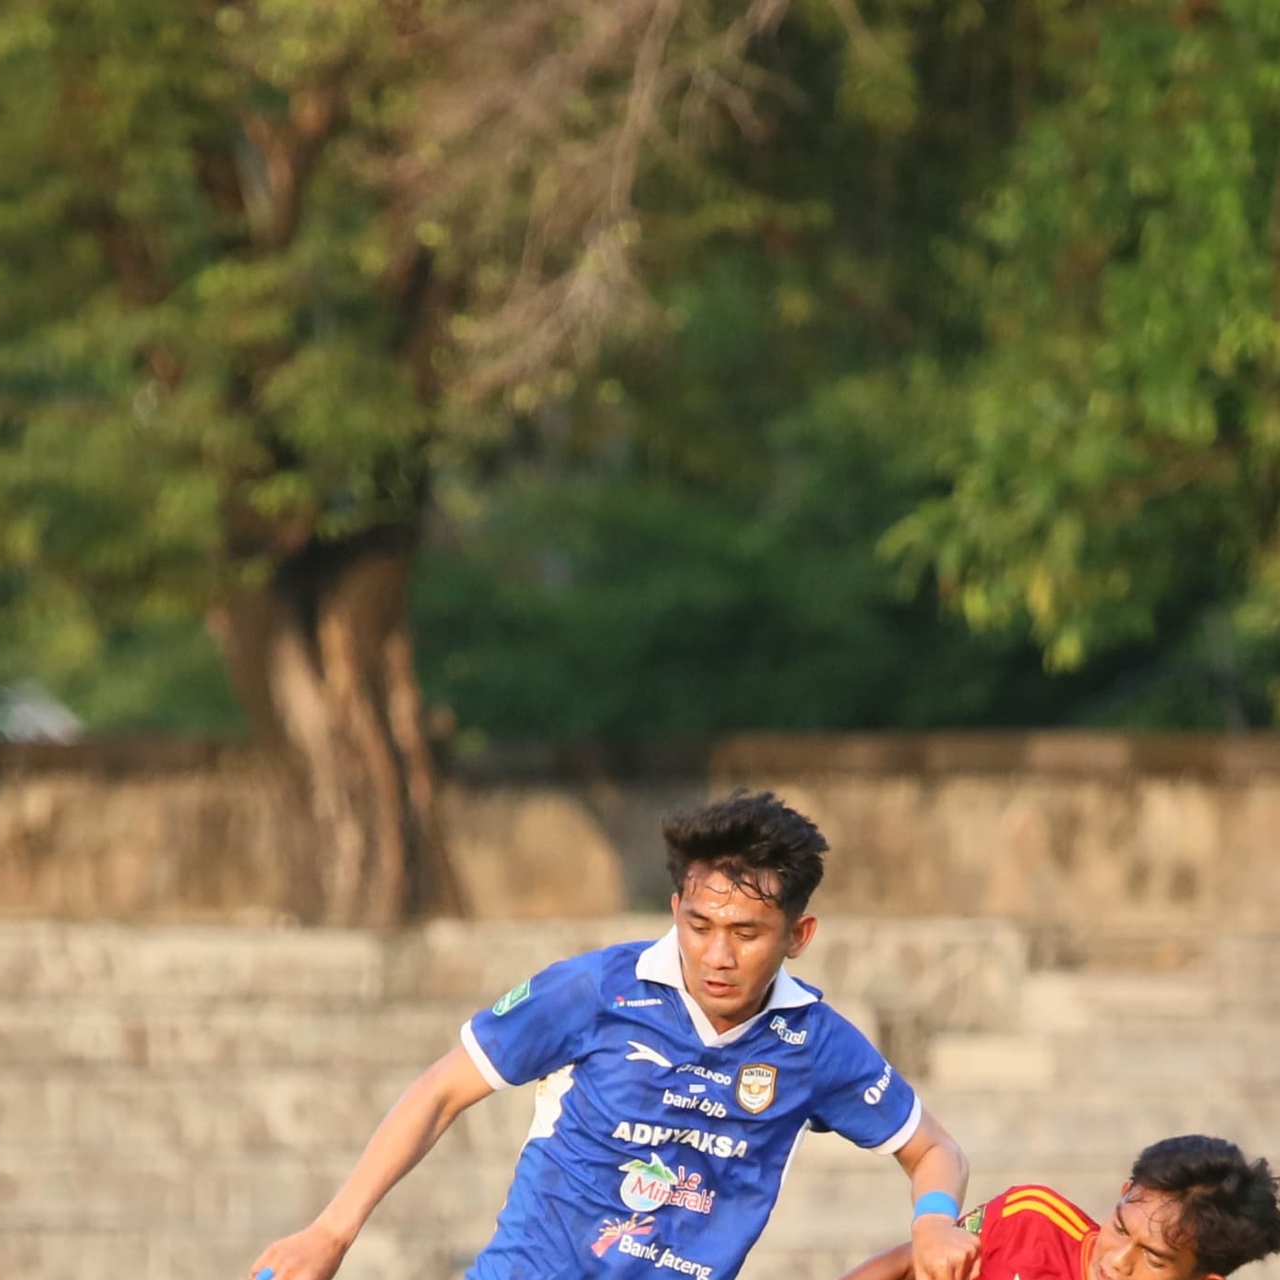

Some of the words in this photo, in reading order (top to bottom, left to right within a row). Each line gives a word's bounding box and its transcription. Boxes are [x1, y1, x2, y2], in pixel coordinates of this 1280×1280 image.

[662, 1089, 699, 1109] bank
[699, 1098, 727, 1118] bjb
[612, 1121, 748, 1158] ADHYAKSA
[676, 1165, 701, 1190] Le
[618, 1234, 658, 1261] Bank
